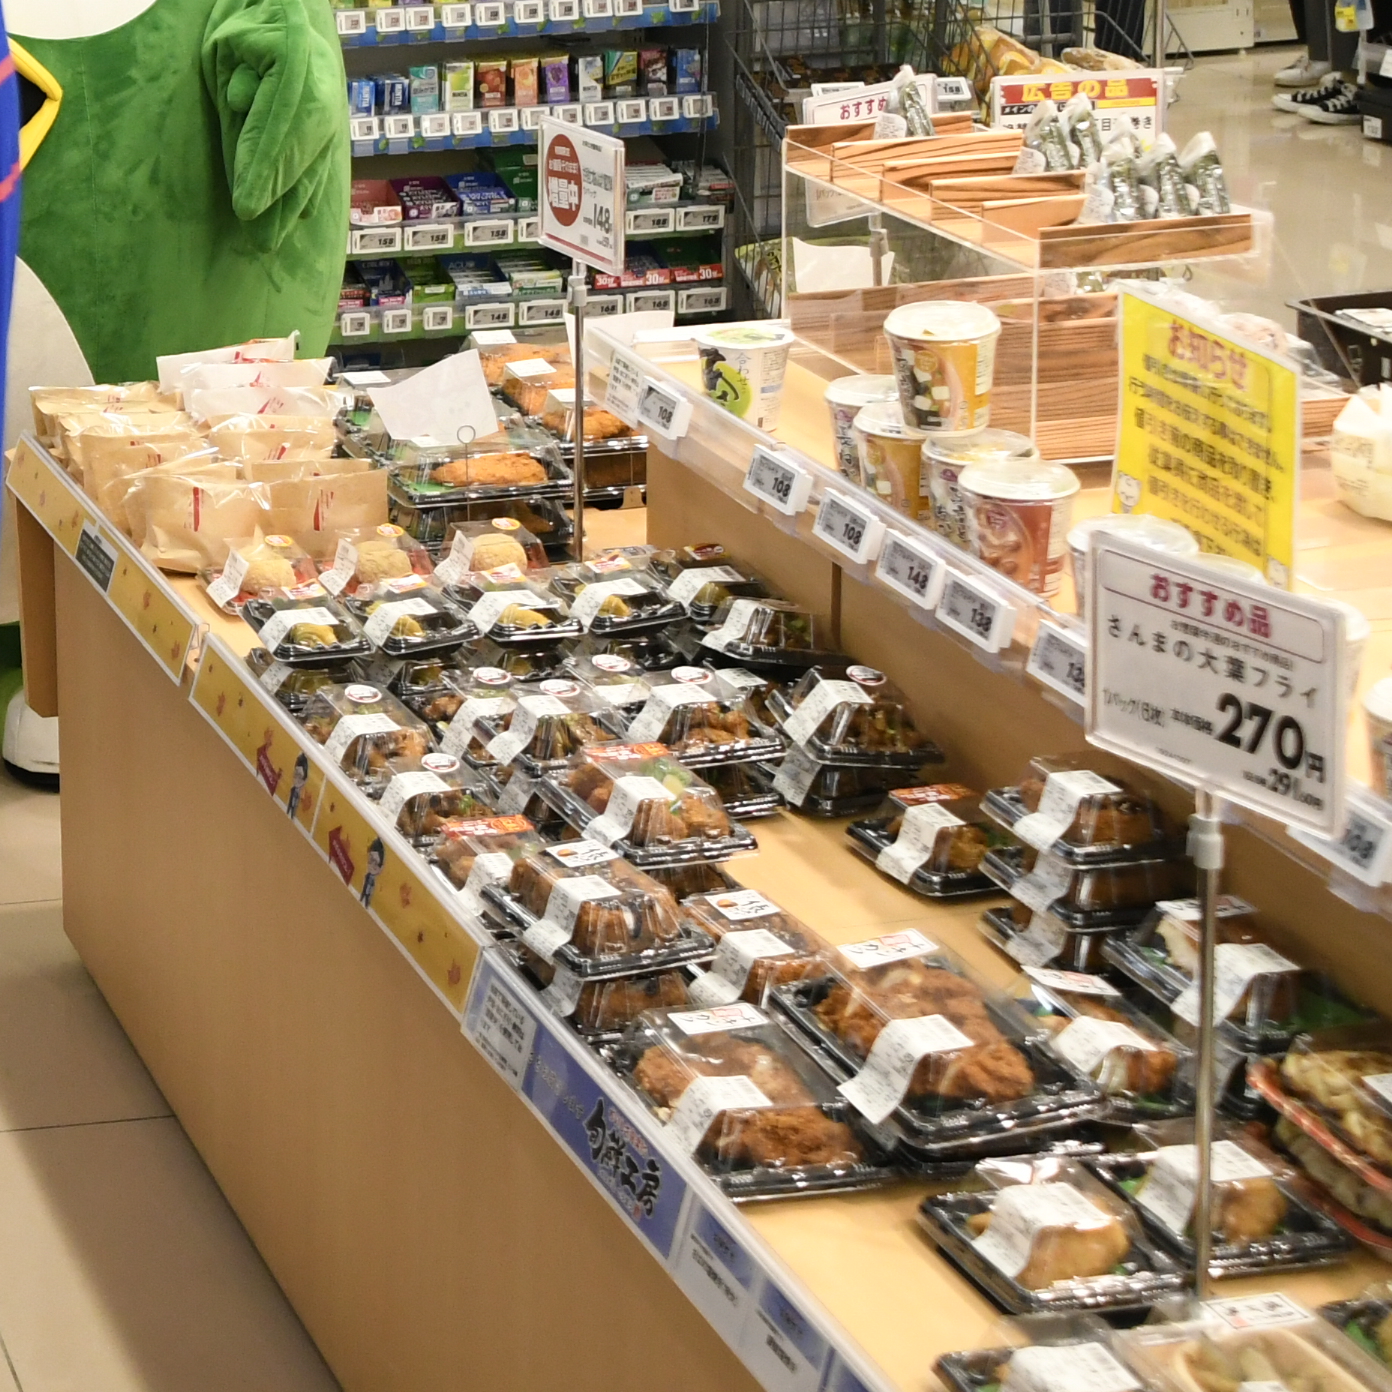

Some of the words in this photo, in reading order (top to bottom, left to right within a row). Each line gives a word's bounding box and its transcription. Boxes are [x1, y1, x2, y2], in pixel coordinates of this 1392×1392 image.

[1022, 79, 1128, 103] 広告の品
[658, 405, 673, 424] 108
[772, 476, 791, 499] 108
[843, 521, 862, 545] 108
[907, 565, 929, 591] 148
[1149, 573, 1272, 639] おすすめ品
[1107, 614, 1319, 708] さんまの大葉フライ
[1215, 691, 1325, 784] 270円
